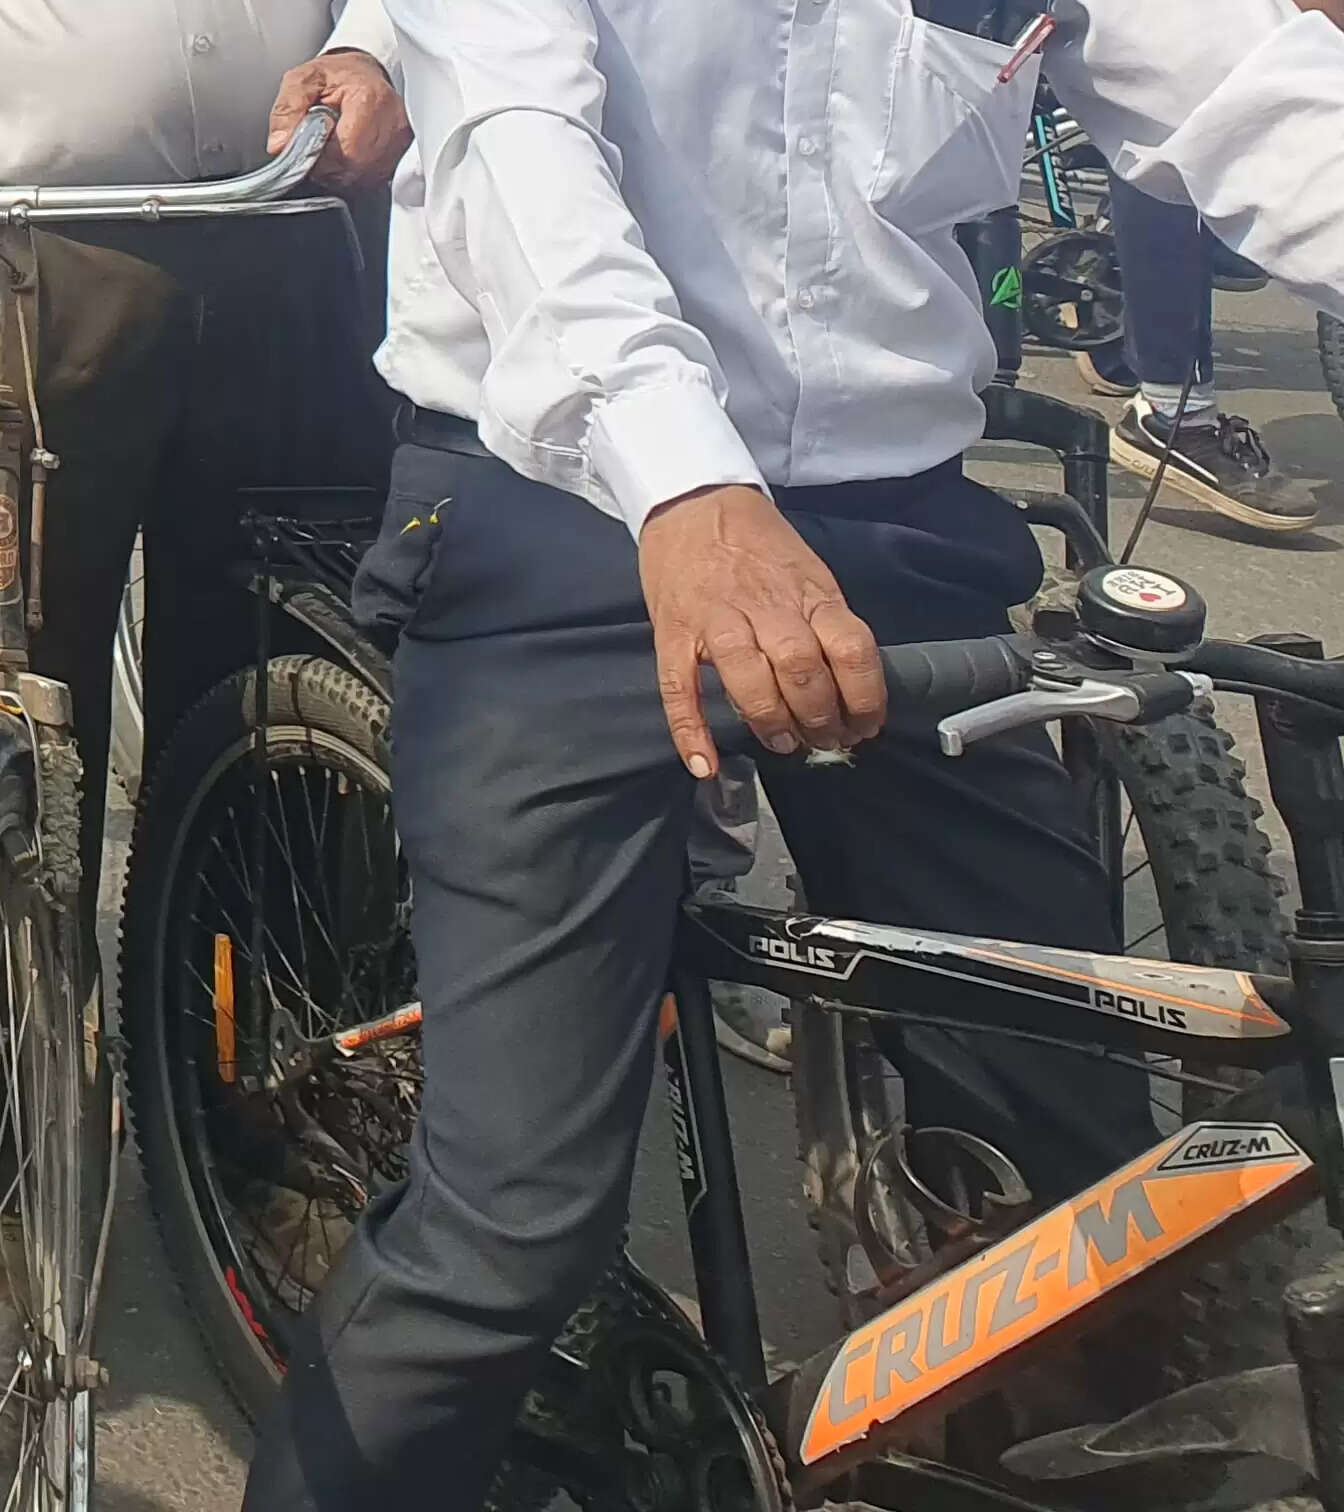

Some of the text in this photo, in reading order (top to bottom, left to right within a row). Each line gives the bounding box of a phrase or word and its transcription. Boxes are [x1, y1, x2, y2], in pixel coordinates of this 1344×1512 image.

[750, 934, 836, 969] POLIS
[1094, 991, 1188, 1030] POLIS
[1183, 1137, 1272, 1162] CRUZ-M
[827, 1179, 1165, 1427] CRUZ-M
